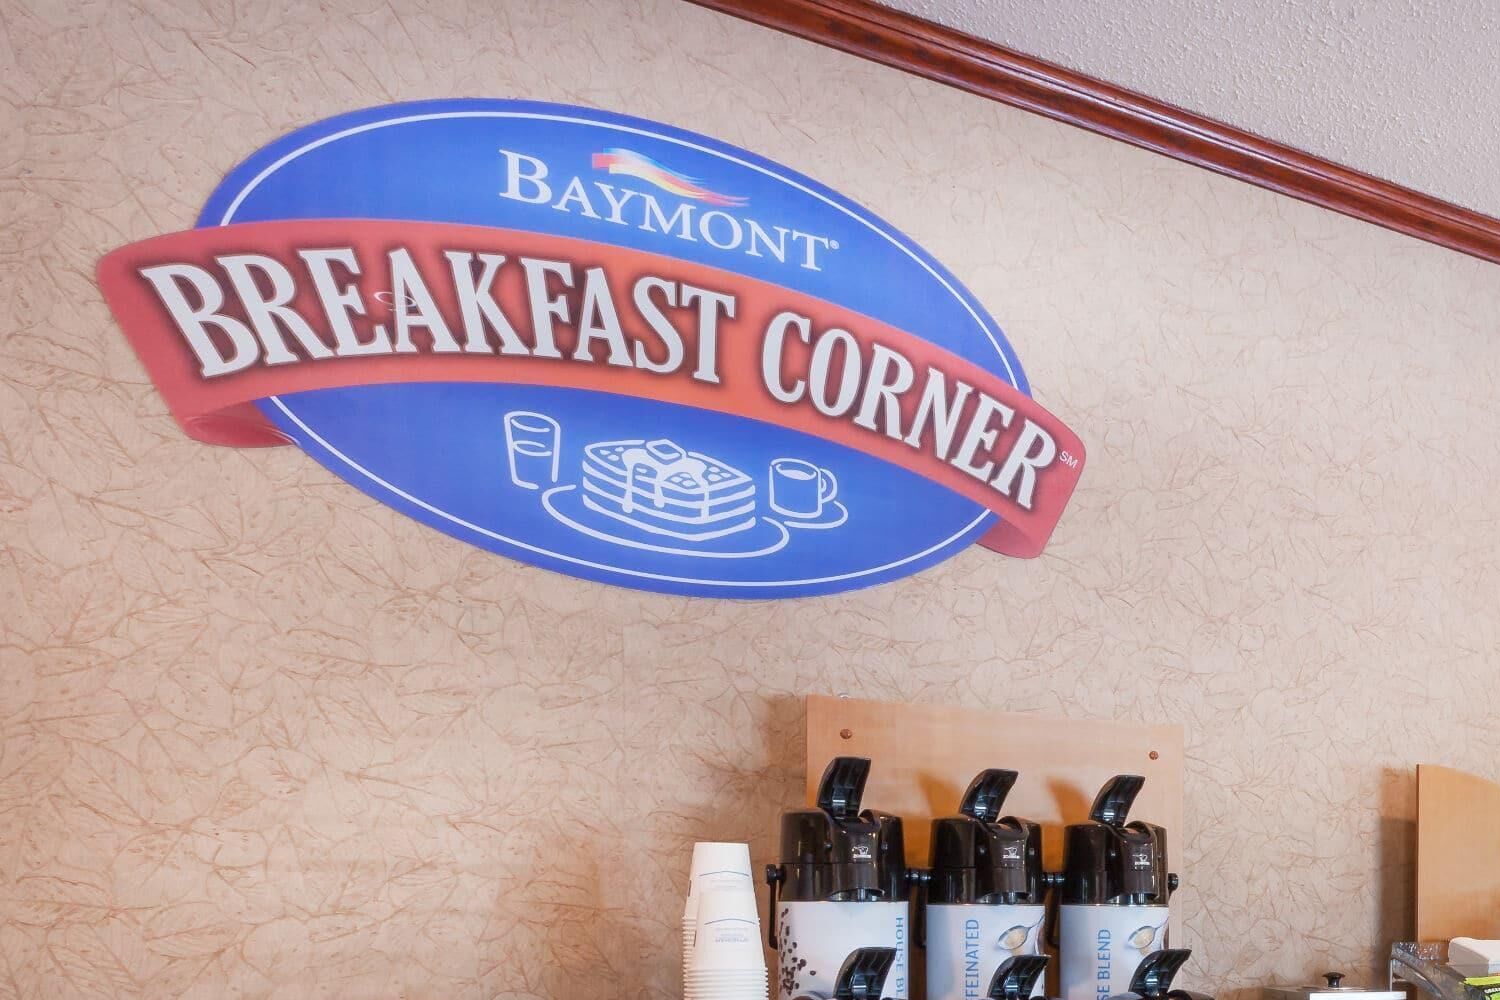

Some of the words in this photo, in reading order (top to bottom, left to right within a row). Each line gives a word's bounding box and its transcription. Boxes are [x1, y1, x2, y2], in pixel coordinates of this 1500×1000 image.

[139, 246, 736, 384] BREAKFAST
[762, 311, 1057, 510] CORNER
[895, 917, 904, 972] HOUSE
[1097, 928, 1111, 980] BLEND
